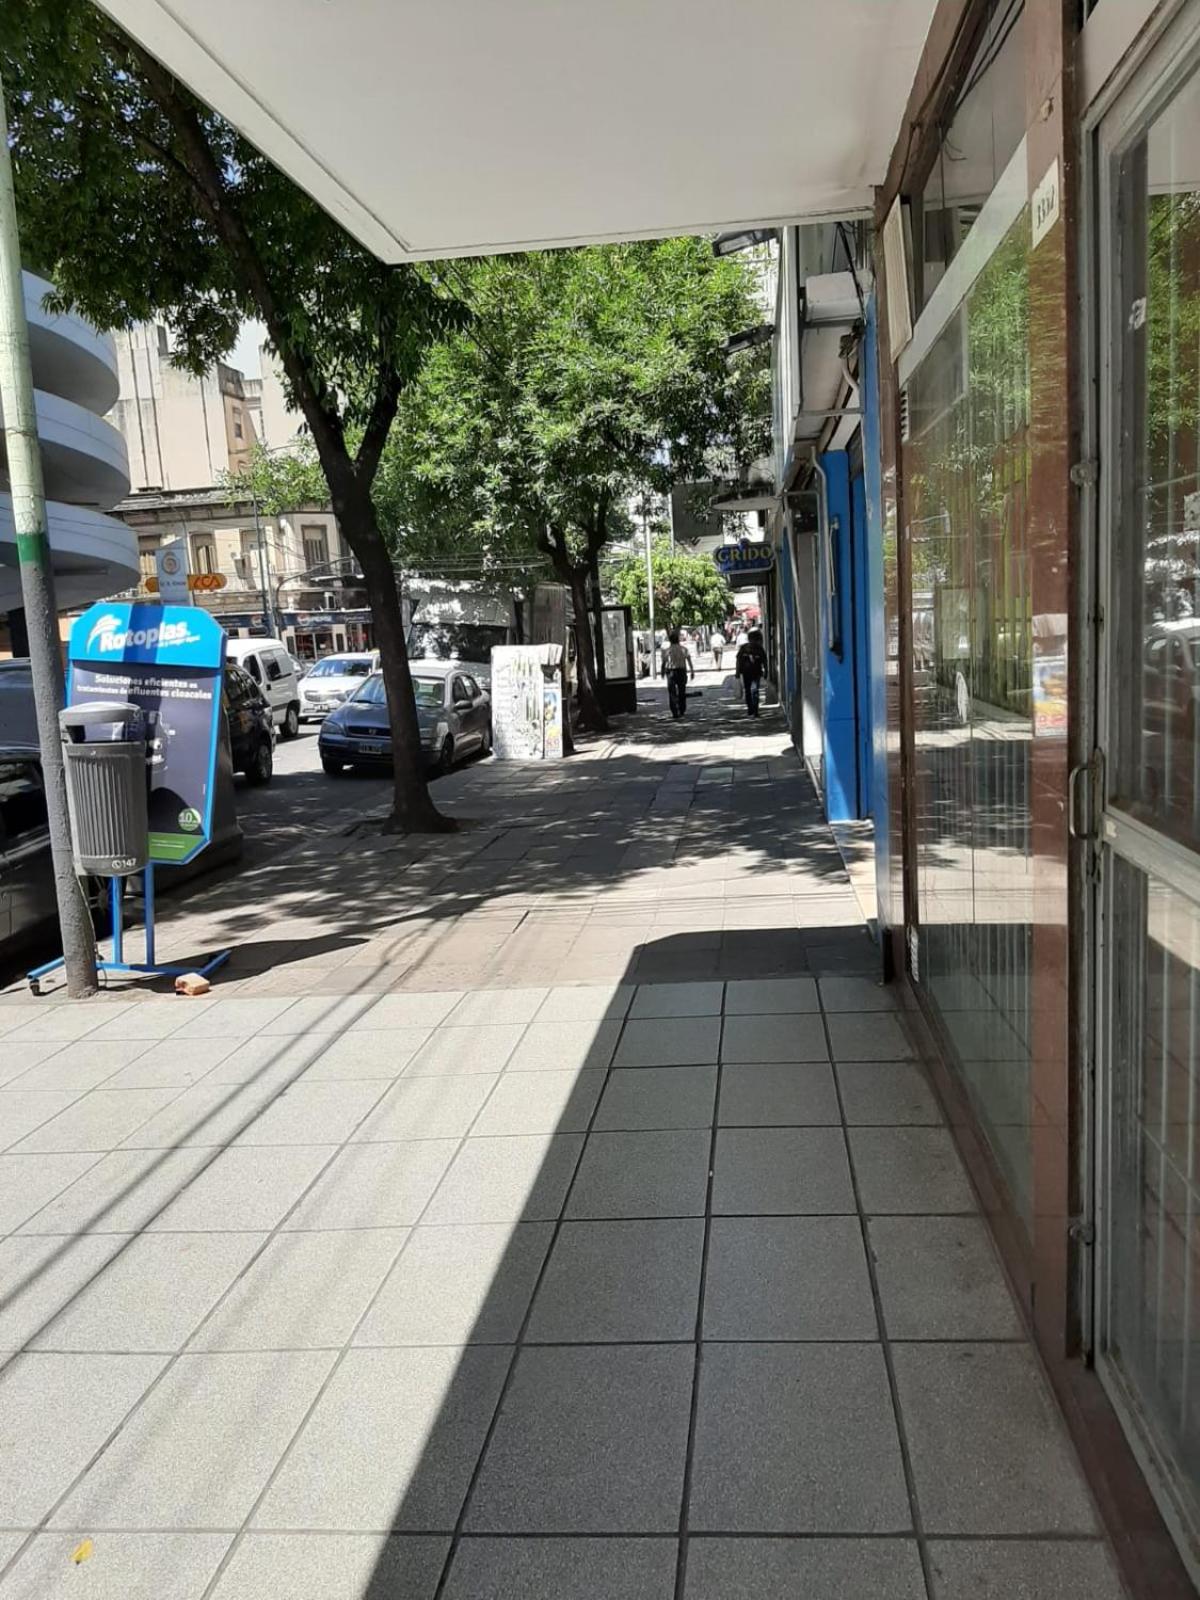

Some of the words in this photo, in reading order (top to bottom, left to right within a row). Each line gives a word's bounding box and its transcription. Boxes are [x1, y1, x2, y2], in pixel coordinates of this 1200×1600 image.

[99, 621, 188, 652] Rotoplas
[95, 674, 143, 686] Soluciones
[144, 677, 188, 689] eficientes
[128, 686, 170, 697] efluentes
[171, 688, 213, 700] cloacales
